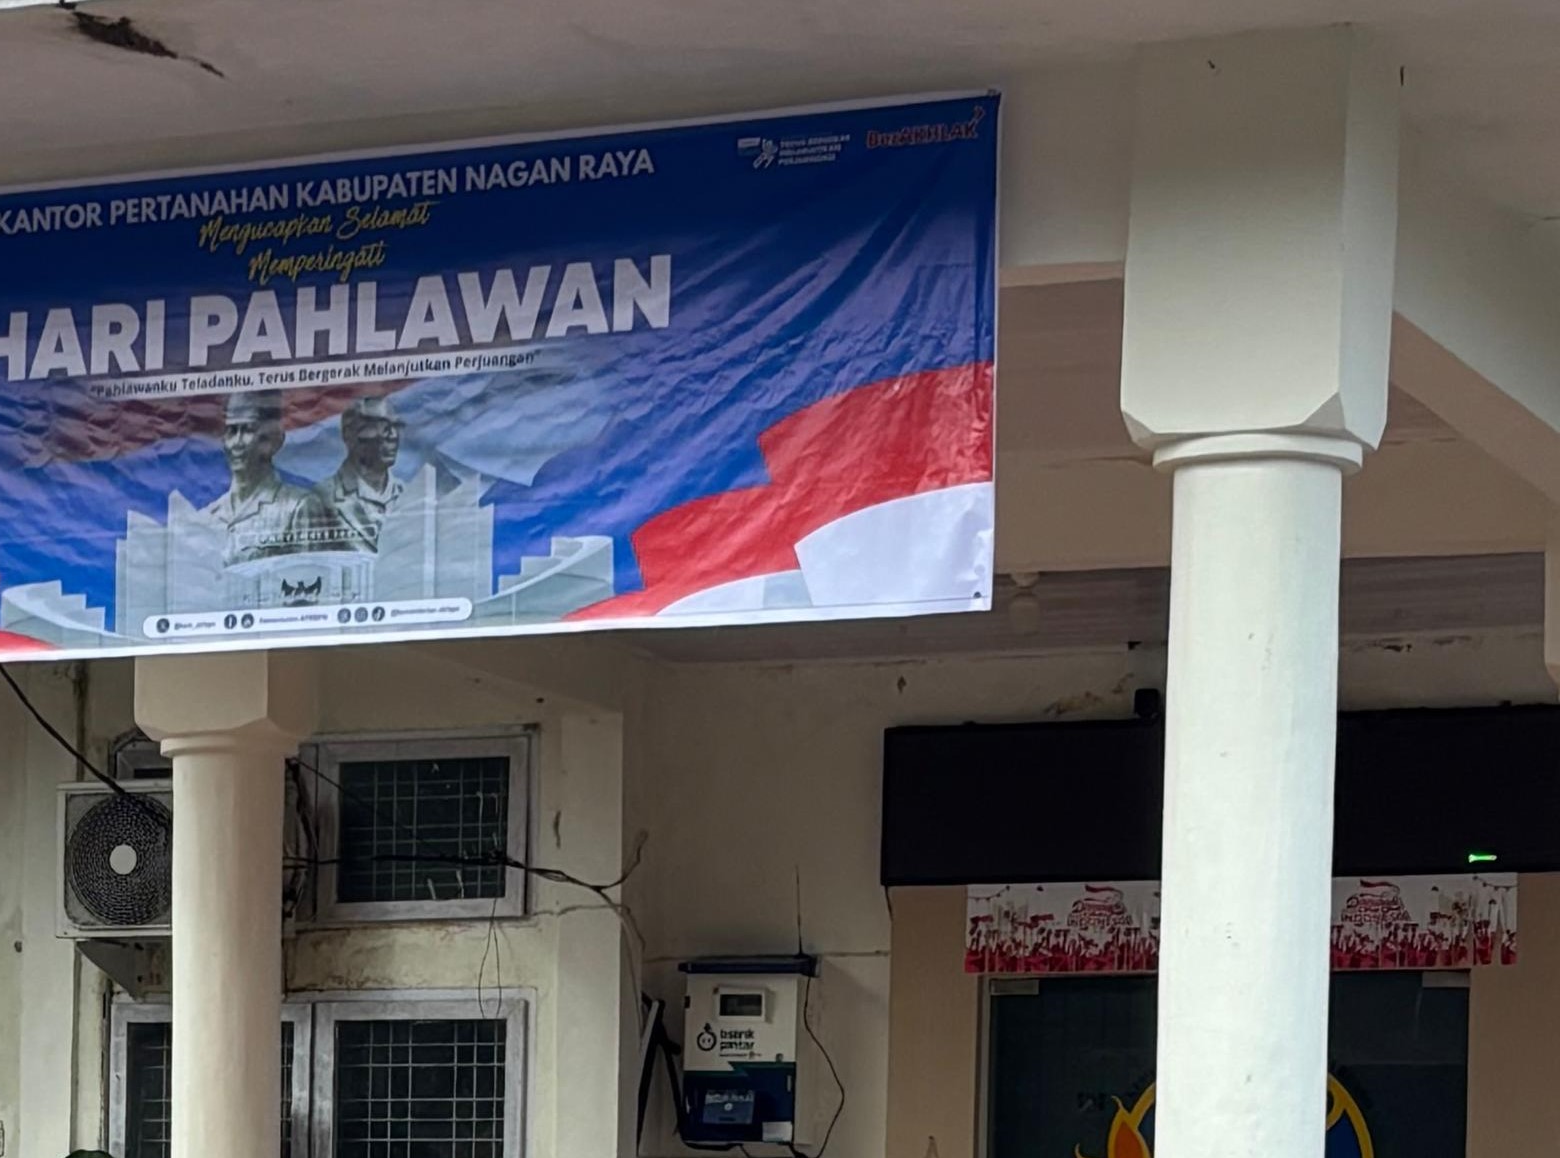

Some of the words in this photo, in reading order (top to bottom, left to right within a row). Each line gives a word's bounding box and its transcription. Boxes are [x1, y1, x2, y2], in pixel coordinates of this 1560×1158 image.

[110, 184, 289, 226] PERTANAHAN
[296, 167, 458, 208] KABUPATEN
[465, 156, 571, 192] NAGAN
[579, 149, 656, 180] RAYA
[198, 213, 333, 255] Mengucapkan
[336, 200, 440, 240] Selamat
[248, 240, 389, 286] Memperingati
[188, 254, 672, 367] PAHLAWAN
[259, 368, 295, 385] Terus
[299, 364, 361, 383] Bergerak
[363, 356, 452, 378] Melanjutkan
